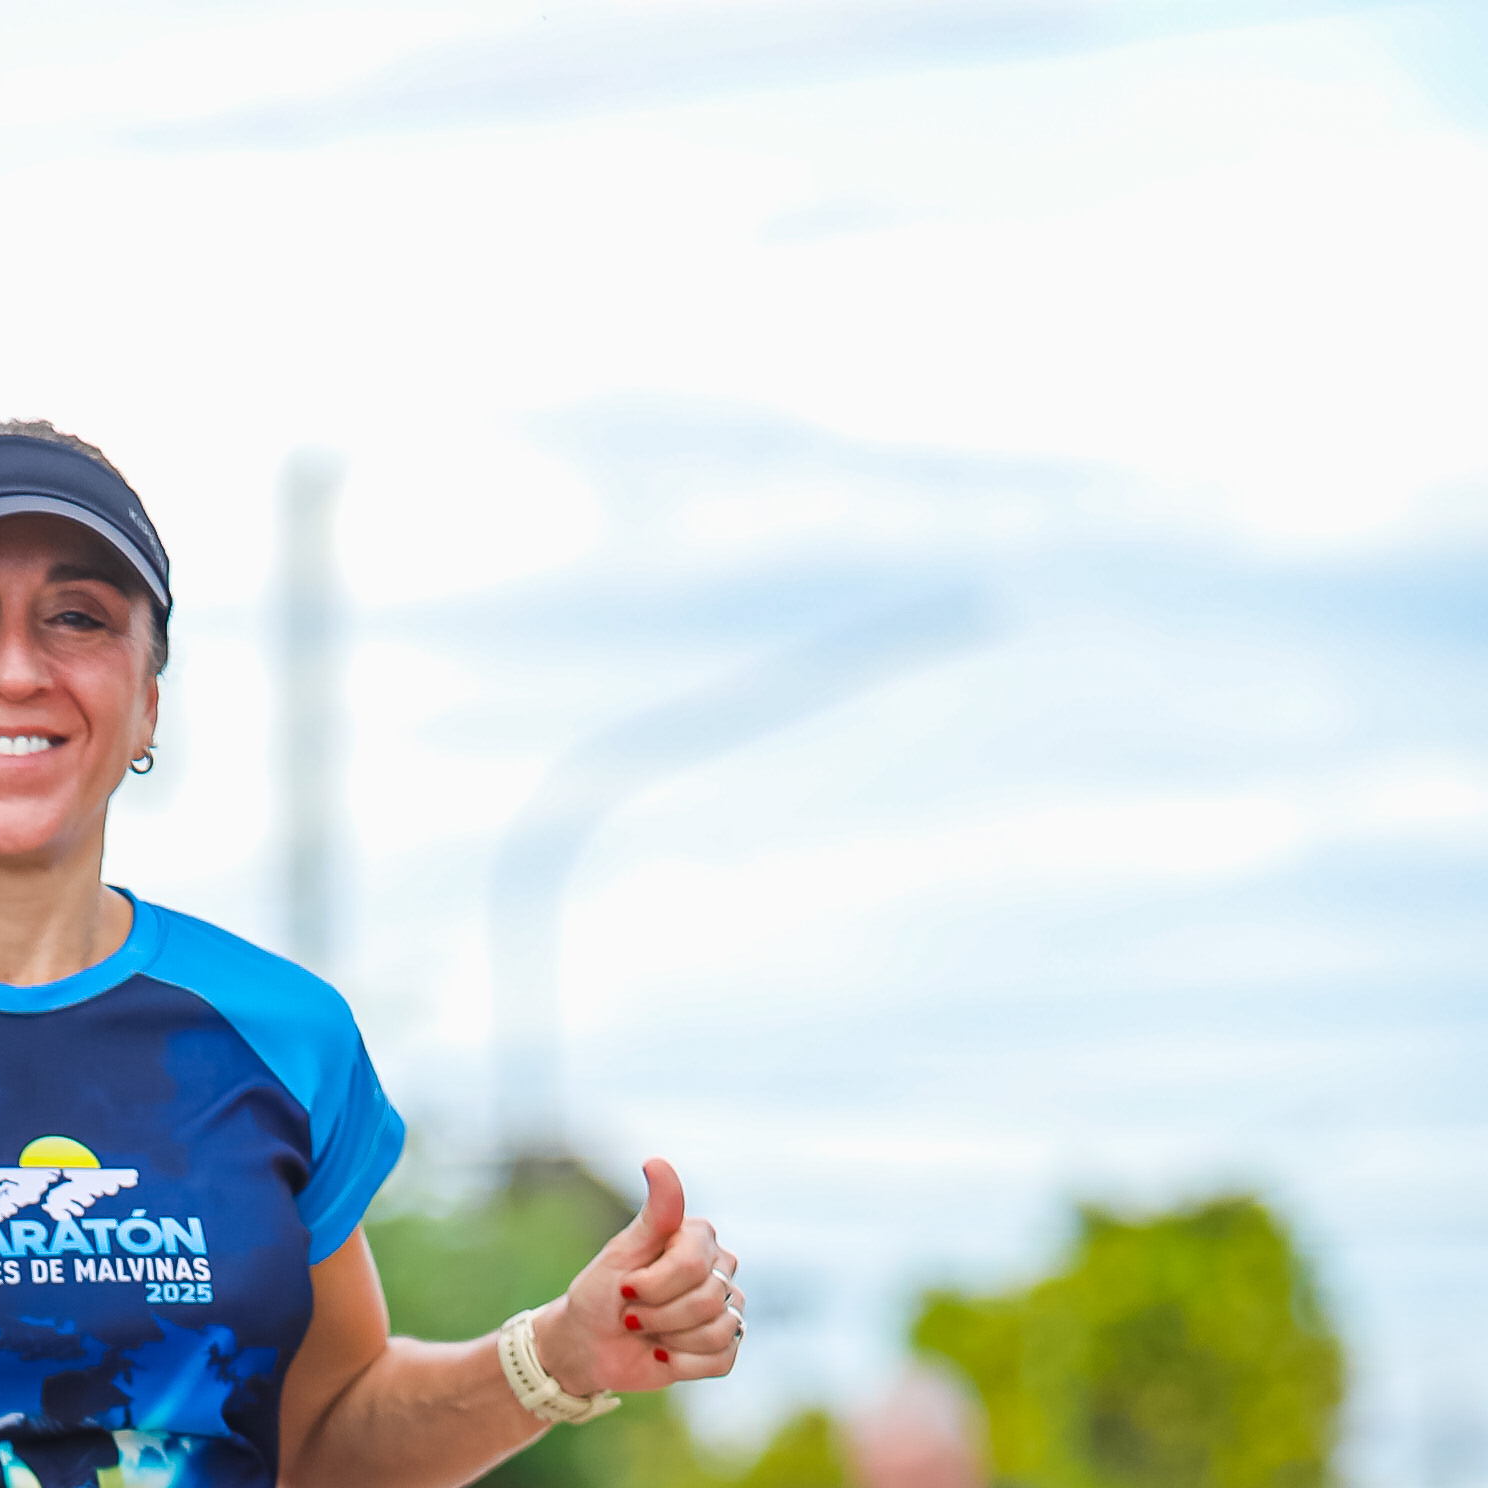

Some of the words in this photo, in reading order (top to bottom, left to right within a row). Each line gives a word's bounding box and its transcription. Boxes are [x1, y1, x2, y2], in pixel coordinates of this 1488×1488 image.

[31, 1259, 64, 1283] DE
[75, 1257, 210, 1282] MALVINAS
[146, 1283, 211, 1303] 2025
